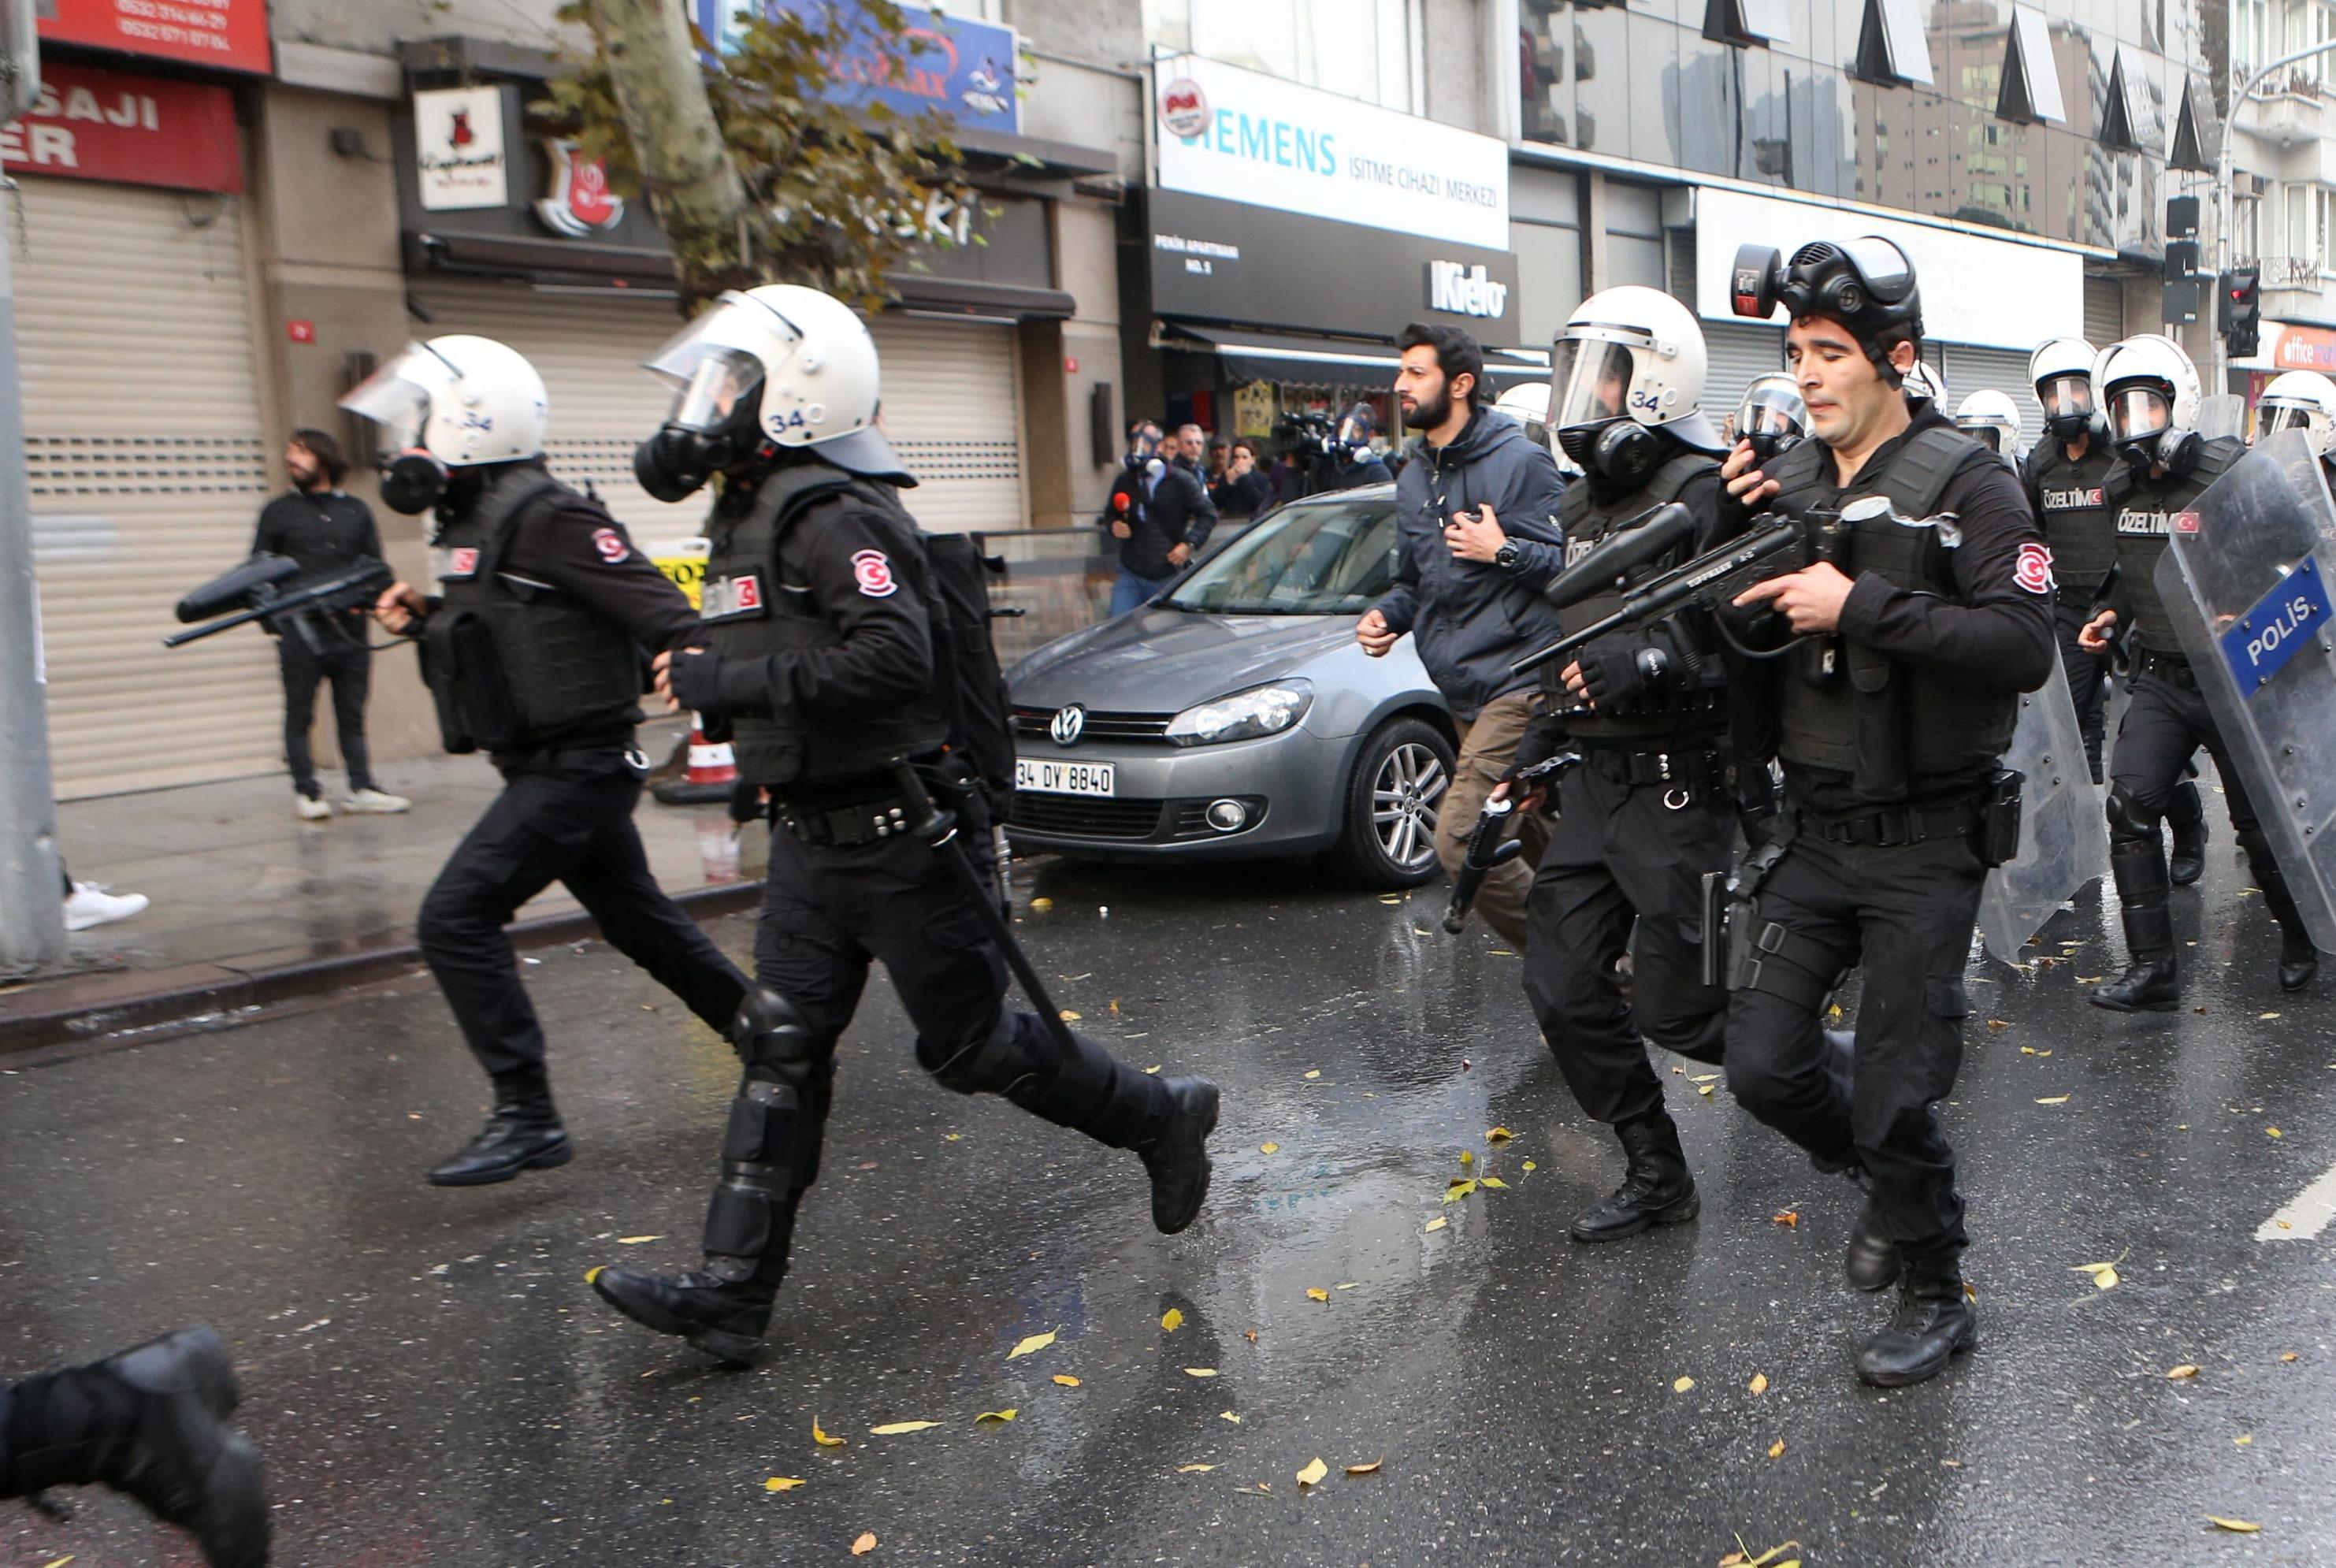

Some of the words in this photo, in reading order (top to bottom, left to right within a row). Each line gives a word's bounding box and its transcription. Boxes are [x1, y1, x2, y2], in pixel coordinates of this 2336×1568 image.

[1631, 391, 1658, 413] 34
[768, 410, 804, 433] 34
[2246, 596, 2311, 667] POLİS
[1016, 763, 1034, 786] 34
[1044, 764, 1061, 789] DV
[1069, 767, 1110, 792] 8840
